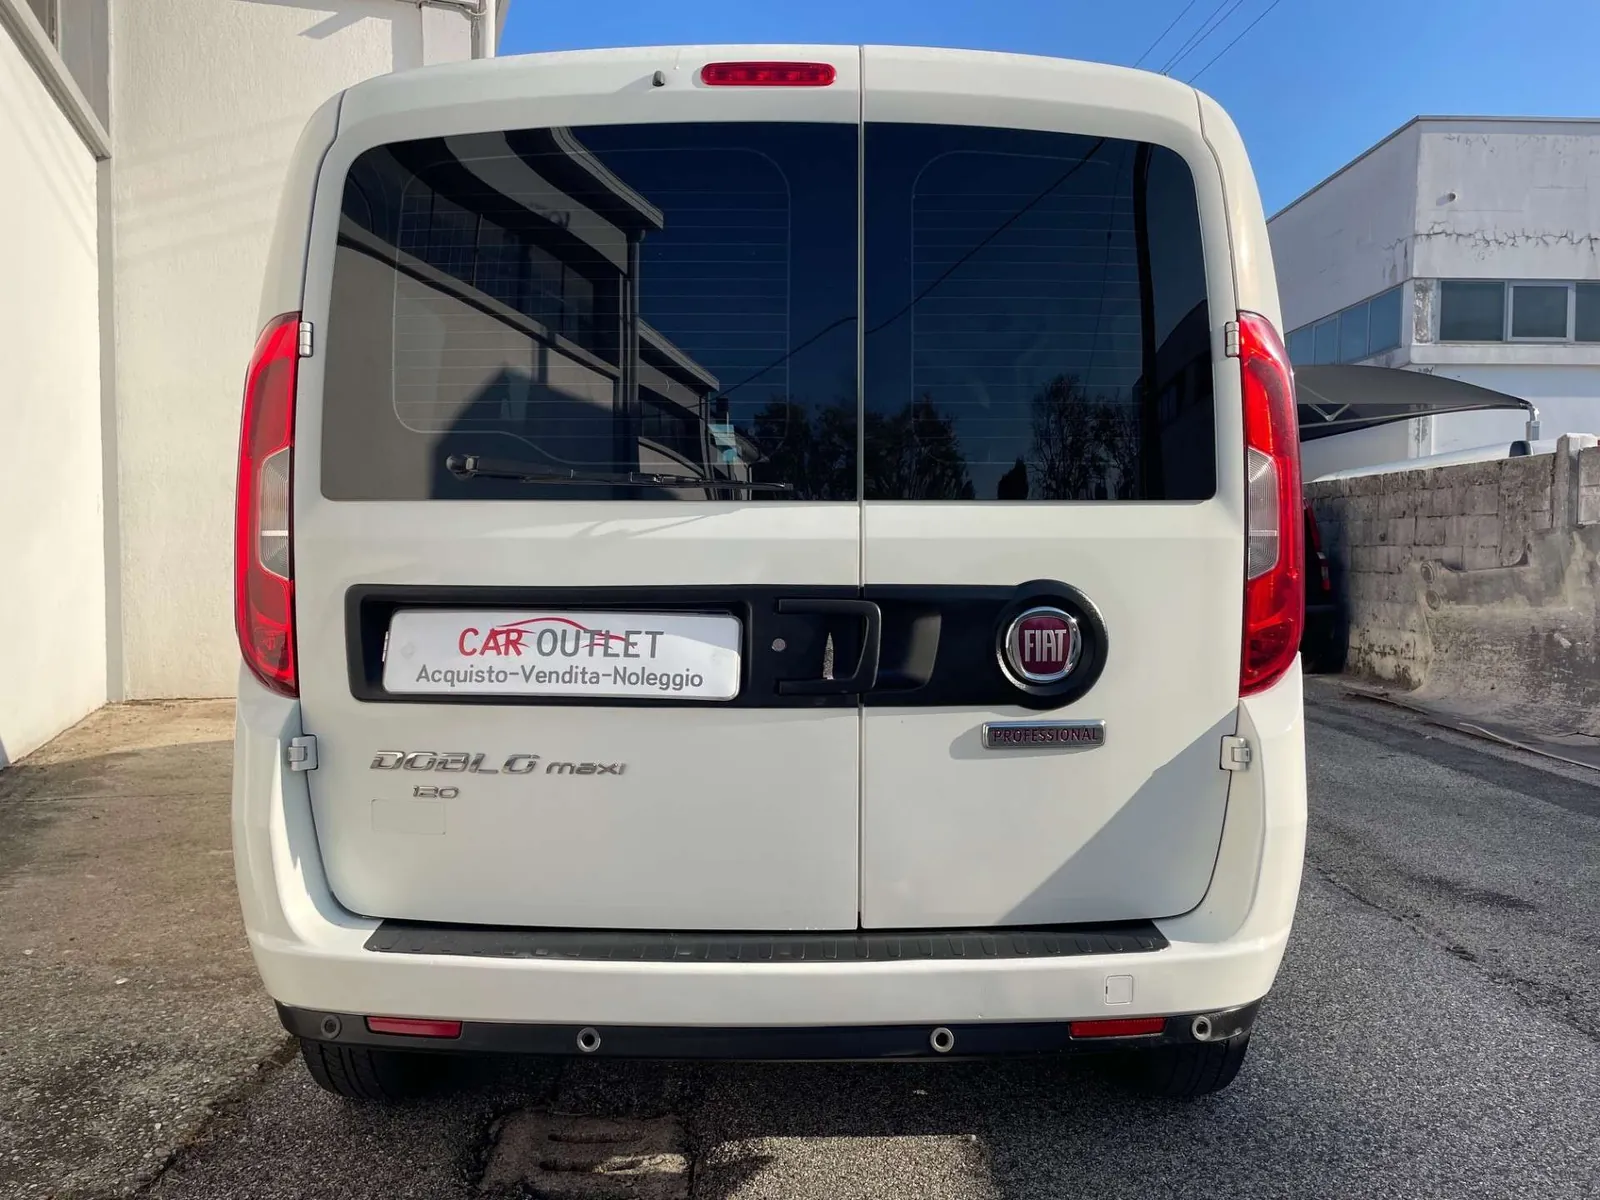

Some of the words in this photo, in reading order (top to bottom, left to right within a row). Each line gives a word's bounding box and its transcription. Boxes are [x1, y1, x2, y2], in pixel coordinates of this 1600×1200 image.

[458, 627, 524, 657] CAR
[537, 630, 665, 659] OUTLET
[1024, 629, 1067, 662] FIAT
[416, 664, 704, 692] Acquisto-Vendita-Noleggio
[993, 726, 1099, 743] PROFESSIONAL
[545, 761, 628, 776] maxi
[412, 785, 460, 799] 120
